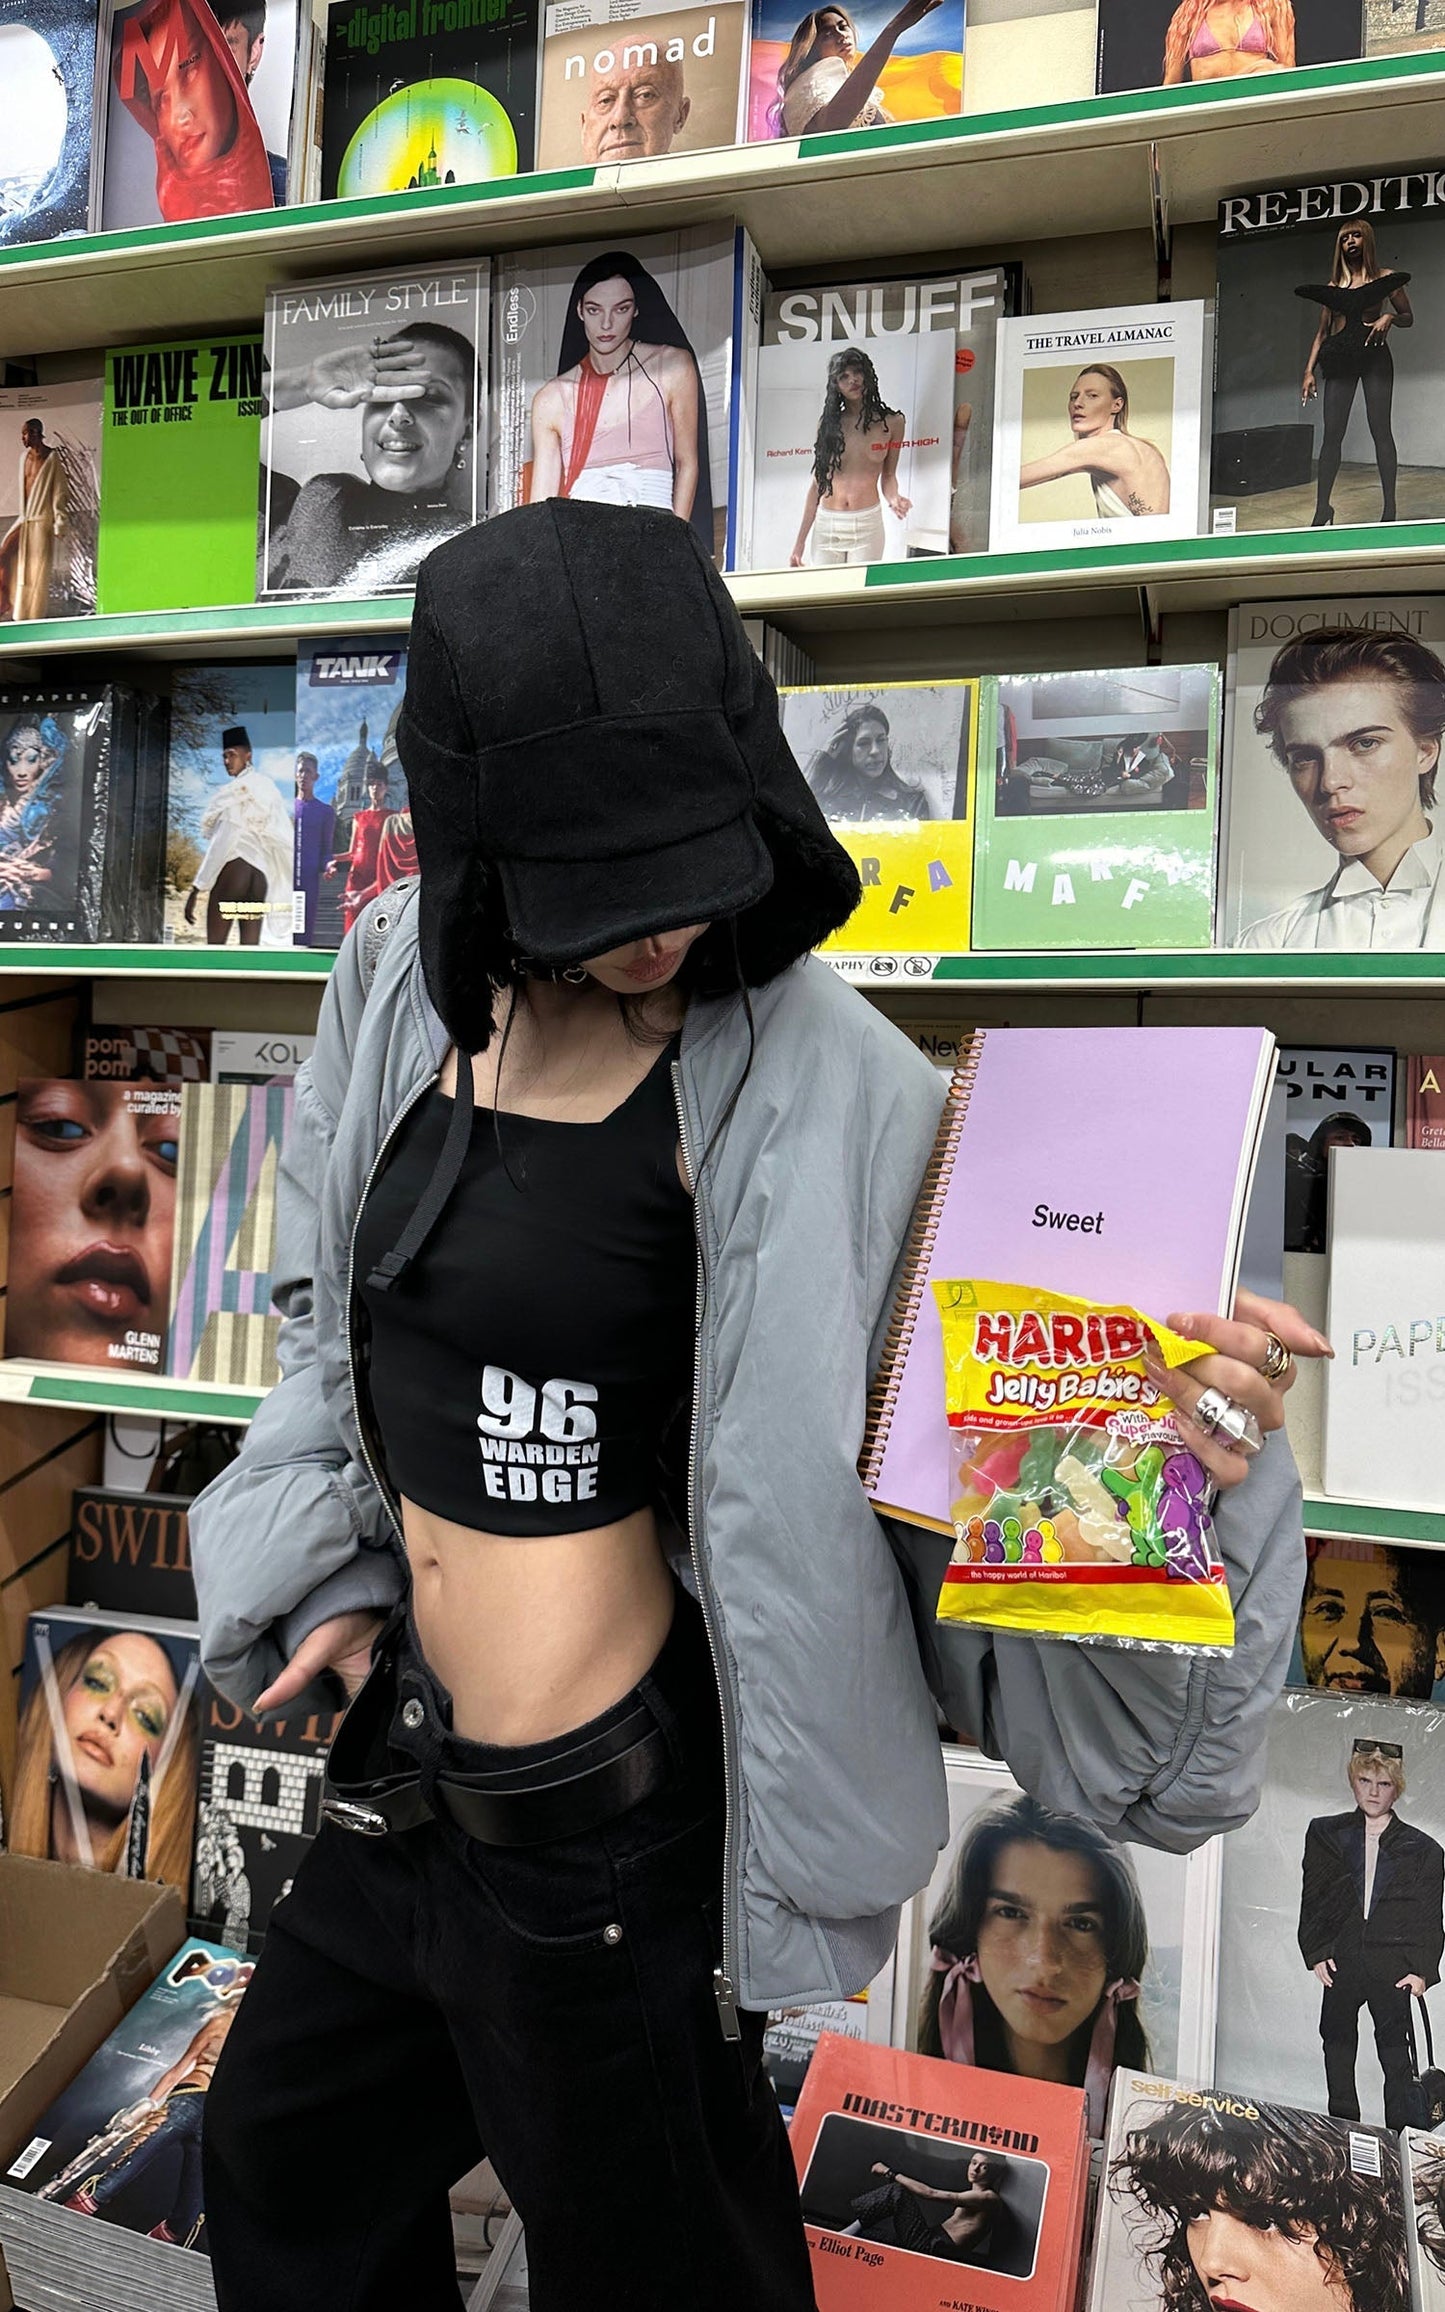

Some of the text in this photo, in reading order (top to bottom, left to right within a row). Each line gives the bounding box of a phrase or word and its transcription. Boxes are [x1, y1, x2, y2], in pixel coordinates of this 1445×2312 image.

[120, 0, 190, 99] M
[565, 16, 717, 80] nomad
[1220, 171, 1445, 234] RE-EDITI
[282, 278, 469, 326] FAMILY STYLE
[506, 287, 520, 343] Endless
[778, 275, 997, 345] SNUFF
[1026, 326, 1173, 350] THE TRAVEL ALMANAC
[113, 349, 199, 408] WAVE
[112, 411, 128, 427] THE
[131, 409, 148, 425] OUT
[151, 408, 162, 423] OF
[164, 405, 193, 422] OFFICE
[767, 449, 793, 458] Richard
[872, 437, 939, 451] SUPER HIGH
[1073, 525, 1112, 538] Julia Nobis
[1250, 610, 1429, 640] DOCUMENT
[316, 655, 393, 679] TANK
[22, 693, 88, 703] PAPER
[86, 1037, 131, 1055] pom
[85, 1058, 131, 1081] pom
[123, 1090, 131, 1101] a
[127, 1103, 182, 1118] curated by
[1032, 1204, 1104, 1234] Sweet
[125, 1330, 161, 1348] GLENN
[973, 1311, 1156, 1367] HARIB
[108, 1343, 159, 1364] MARTENS
[989, 1367, 1161, 1409] Jelly Babies
[477, 1365, 599, 1443] 96
[963, 1414, 977, 1423] kids
[979, 1415, 994, 1424] and
[1108, 1412, 1178, 1438] With Super Ju
[478, 1437, 600, 1466] WARDEN
[482, 1463, 599, 1503] EDGE
[970, 1570, 1067, 1580] the happy world of Haribo!
[1130, 2079, 1260, 2121] self service
[819, 2237, 885, 2267] Elliot Page
